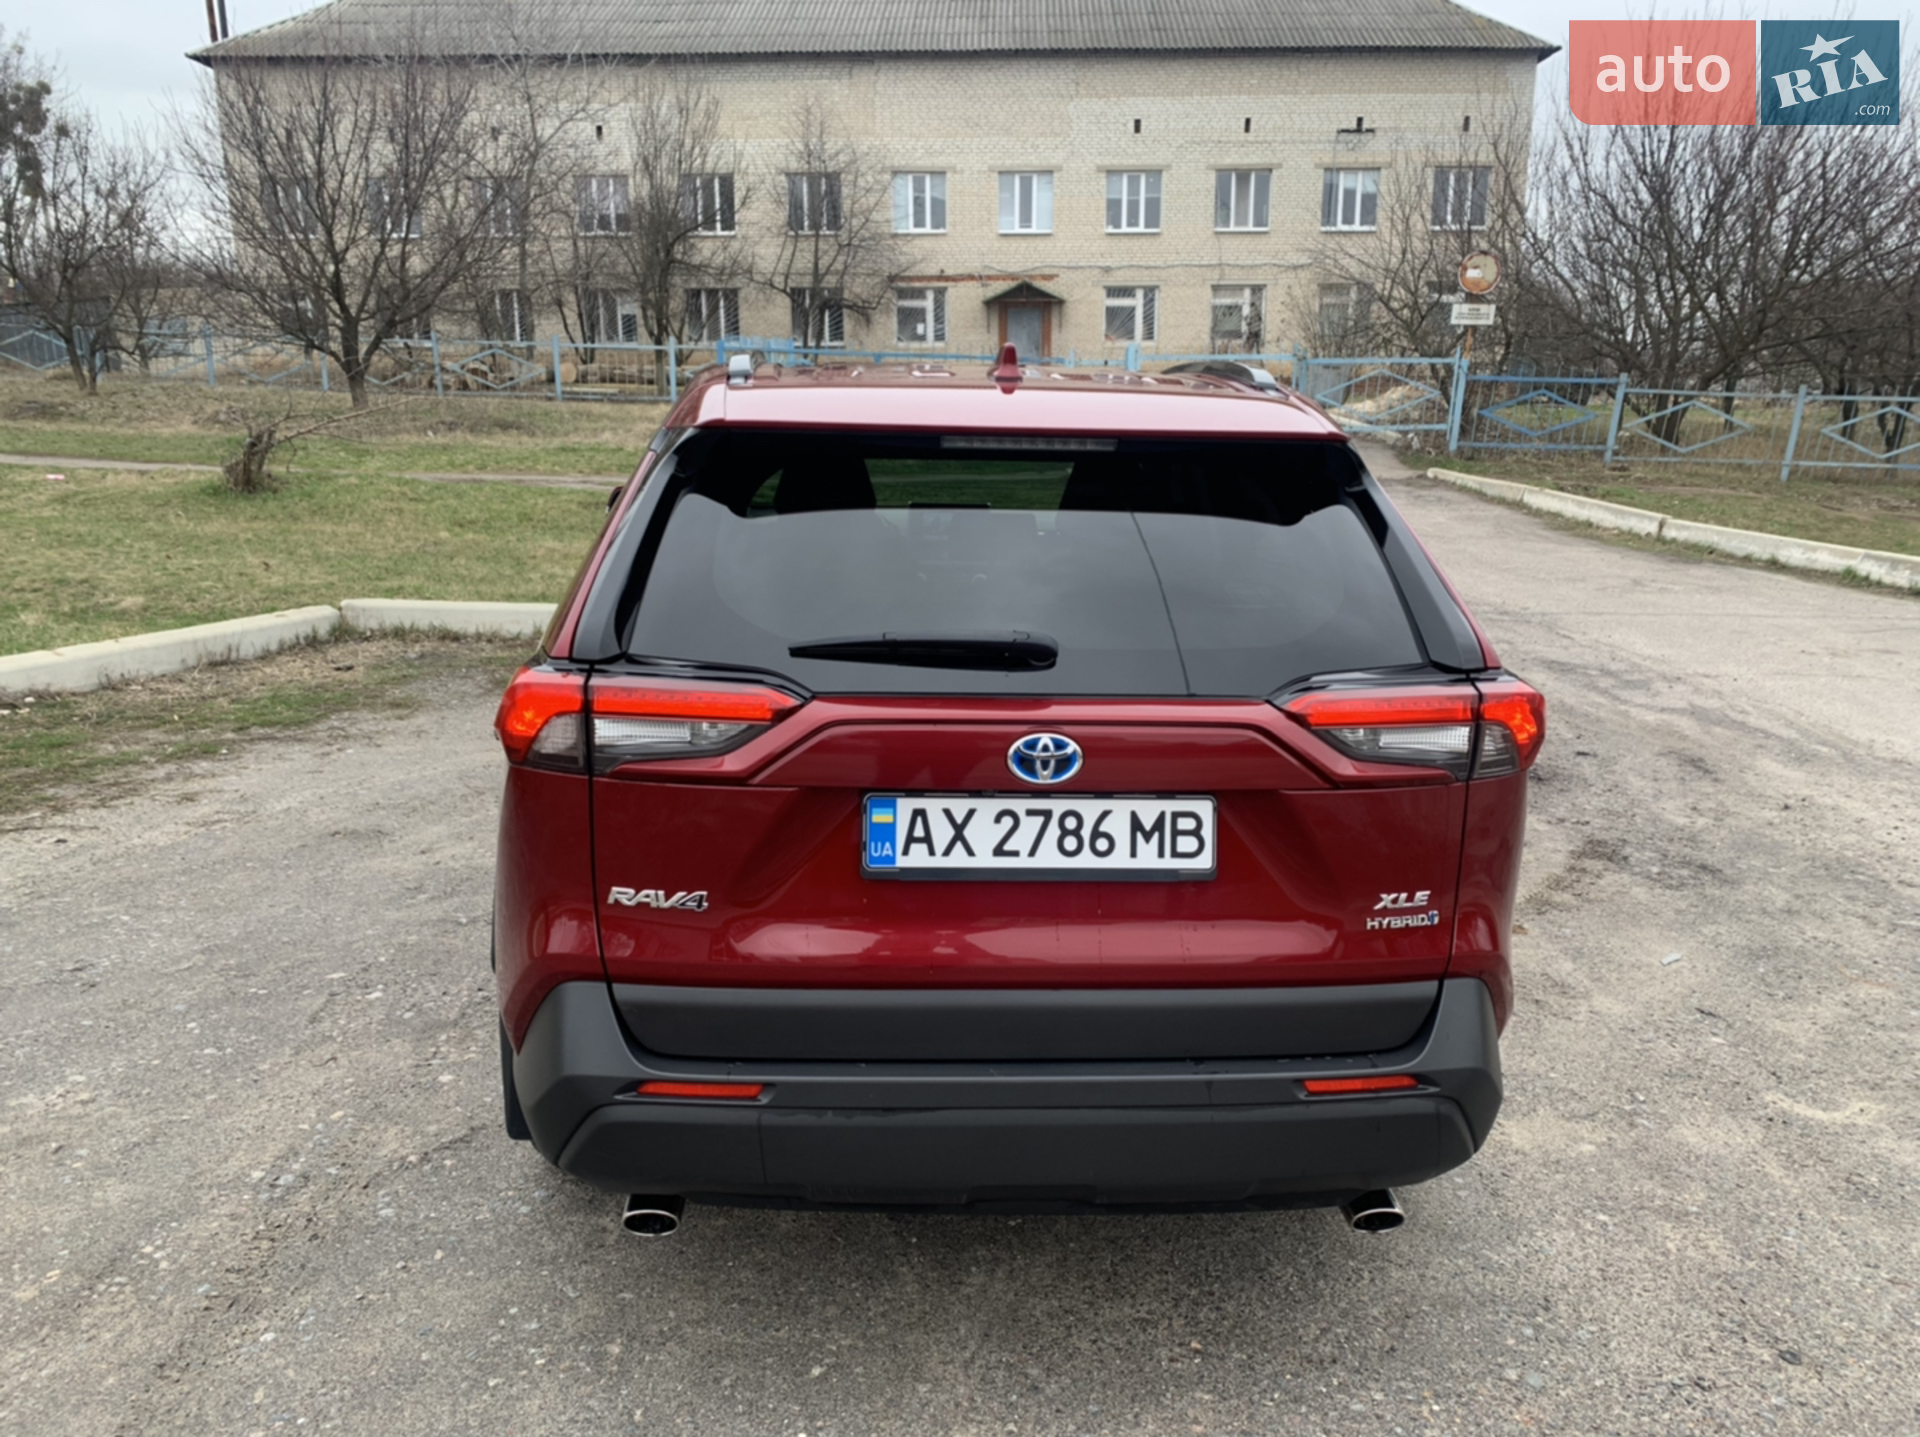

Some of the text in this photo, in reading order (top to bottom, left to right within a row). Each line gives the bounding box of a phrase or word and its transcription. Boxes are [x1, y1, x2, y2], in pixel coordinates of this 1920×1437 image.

[901, 808, 1206, 859] AX 2786 MB
[870, 842, 894, 857] UA
[607, 886, 709, 912] RAV4
[1373, 890, 1432, 910] XLE
[1366, 913, 1428, 930] HYBRID
